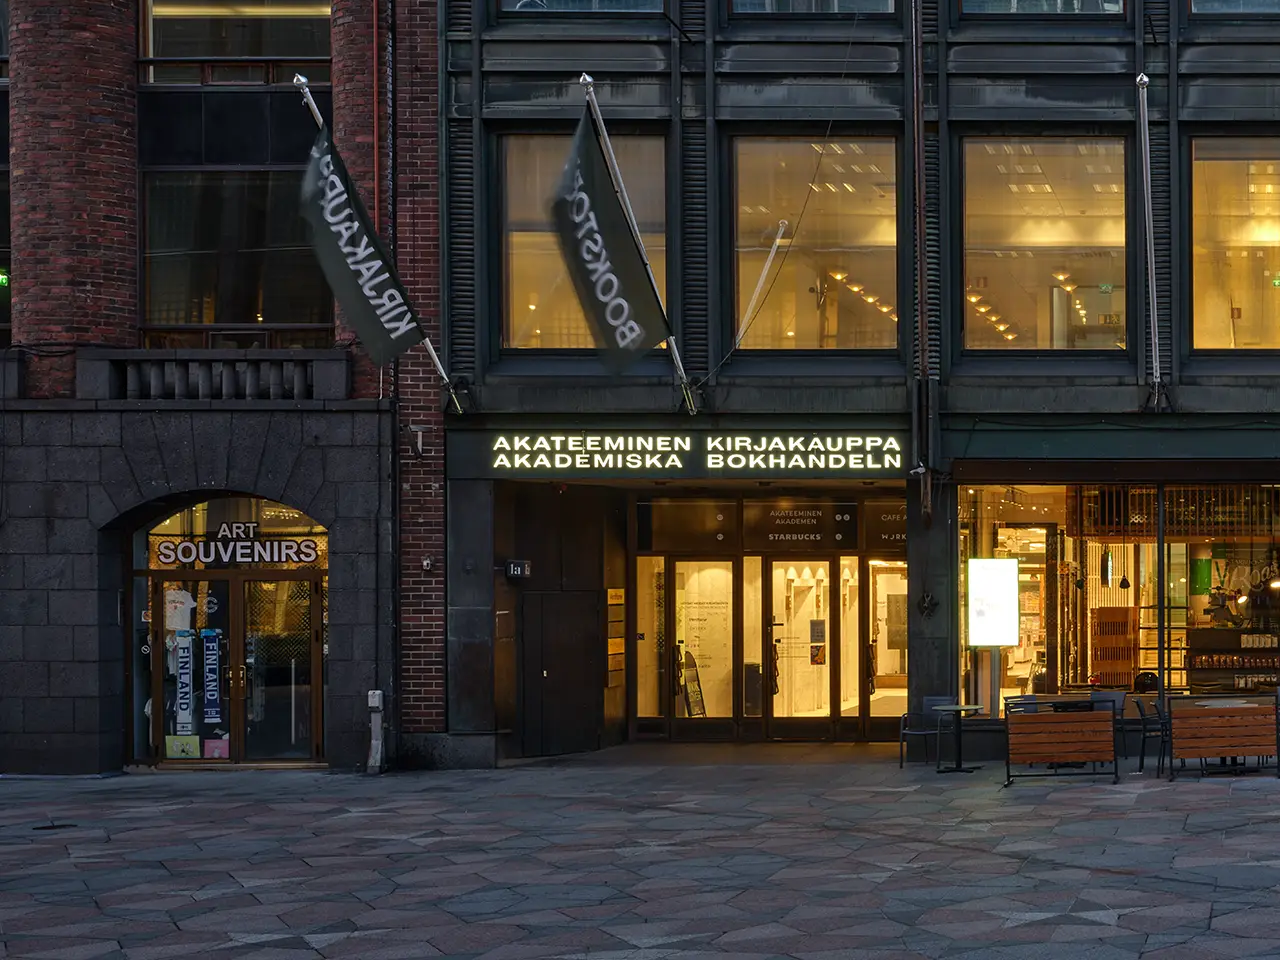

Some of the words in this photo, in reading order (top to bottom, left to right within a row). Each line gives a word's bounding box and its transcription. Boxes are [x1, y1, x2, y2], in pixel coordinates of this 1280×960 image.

[492, 436, 691, 452] AKATEEMINEN
[707, 436, 901, 452] KIRJAKAUPPA
[493, 453, 684, 469] AKADEMISKA
[707, 453, 901, 469] BOKHANDELN
[217, 523, 257, 539] ART
[768, 533, 821, 541] STARBUCKS
[158, 540, 317, 563] SOUVENIRS
[178, 646, 189, 711] FINLAND
[205, 642, 217, 701] FINLAND
